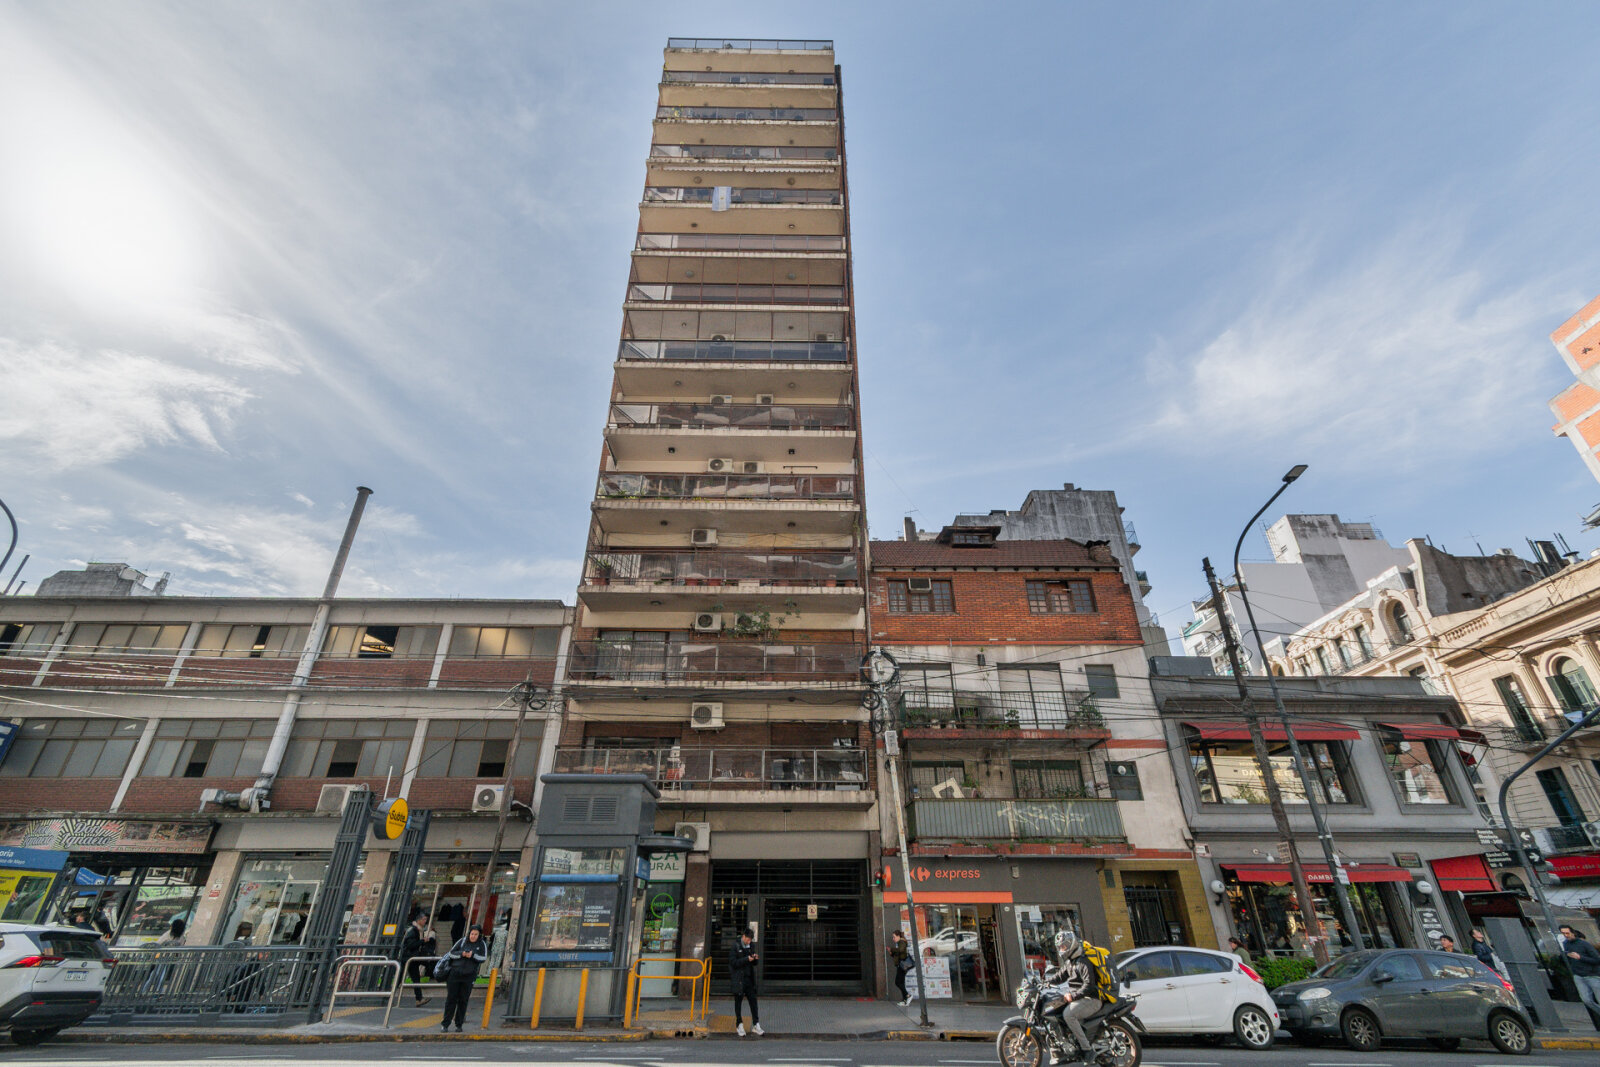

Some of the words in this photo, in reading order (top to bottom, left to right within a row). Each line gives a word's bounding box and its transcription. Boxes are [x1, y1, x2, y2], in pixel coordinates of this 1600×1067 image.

[74, 821, 100, 834] Don
[60, 833, 111, 849] Ignacio
[934, 869, 981, 881] express
